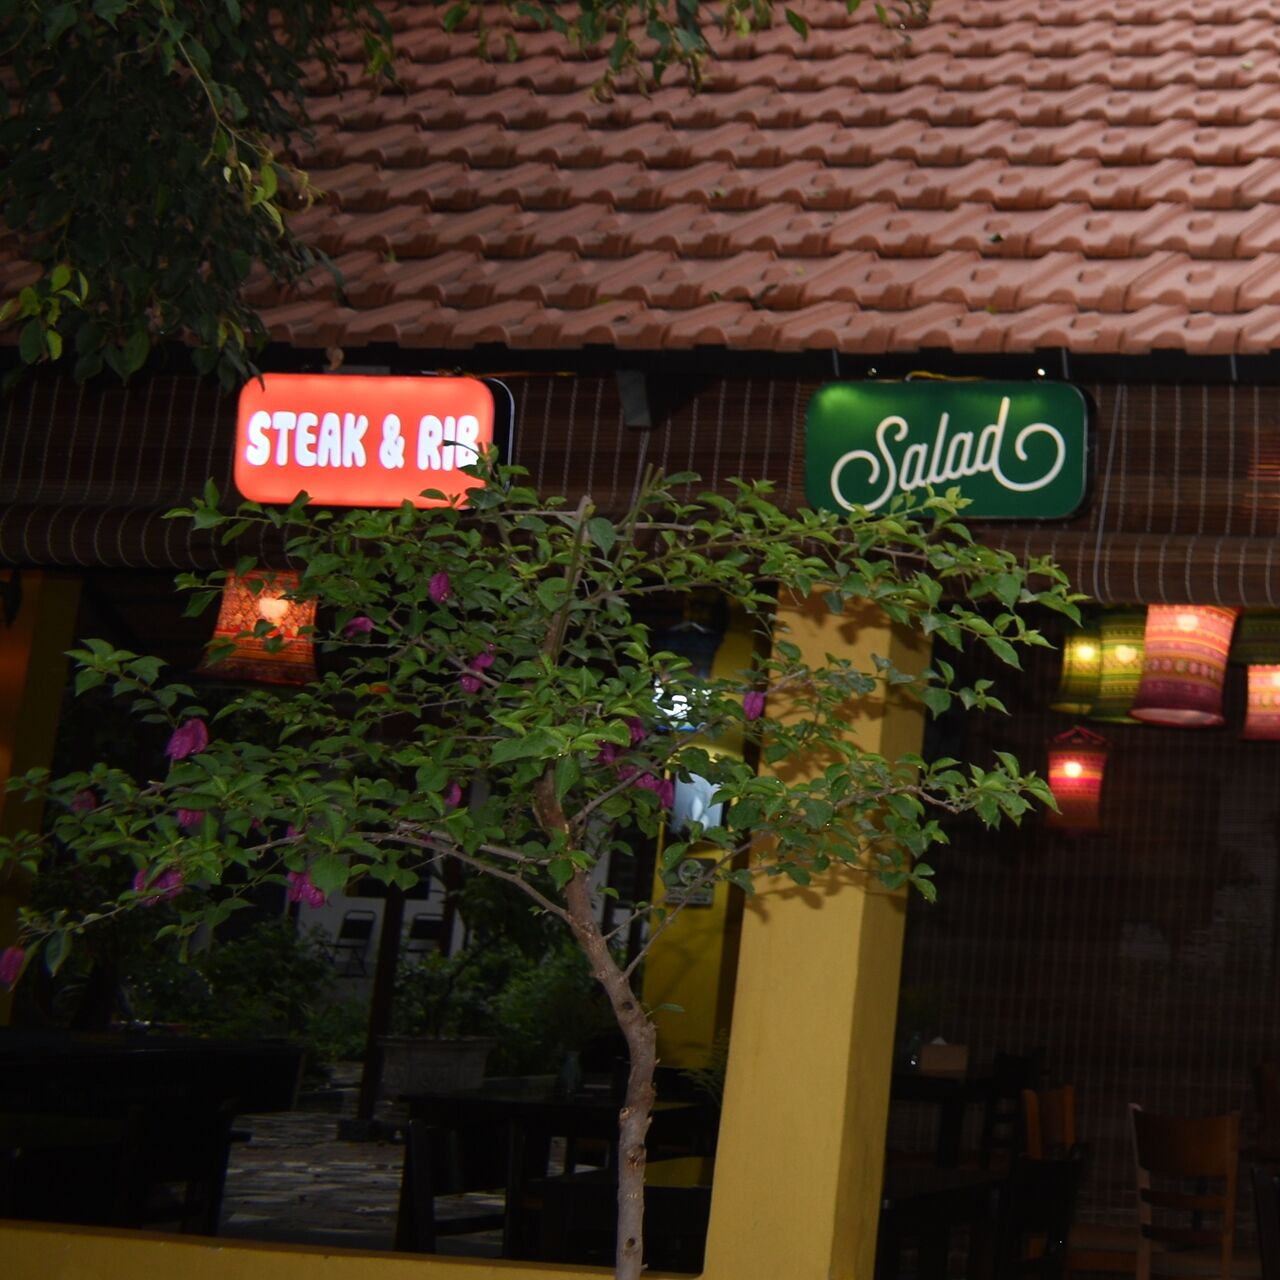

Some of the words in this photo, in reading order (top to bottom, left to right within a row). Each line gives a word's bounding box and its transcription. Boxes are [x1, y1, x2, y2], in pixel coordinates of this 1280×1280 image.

[245, 410, 368, 468] STEAK
[378, 413, 405, 469] &
[416, 414, 479, 471] RIB
[830, 396, 1066, 513] Salad
